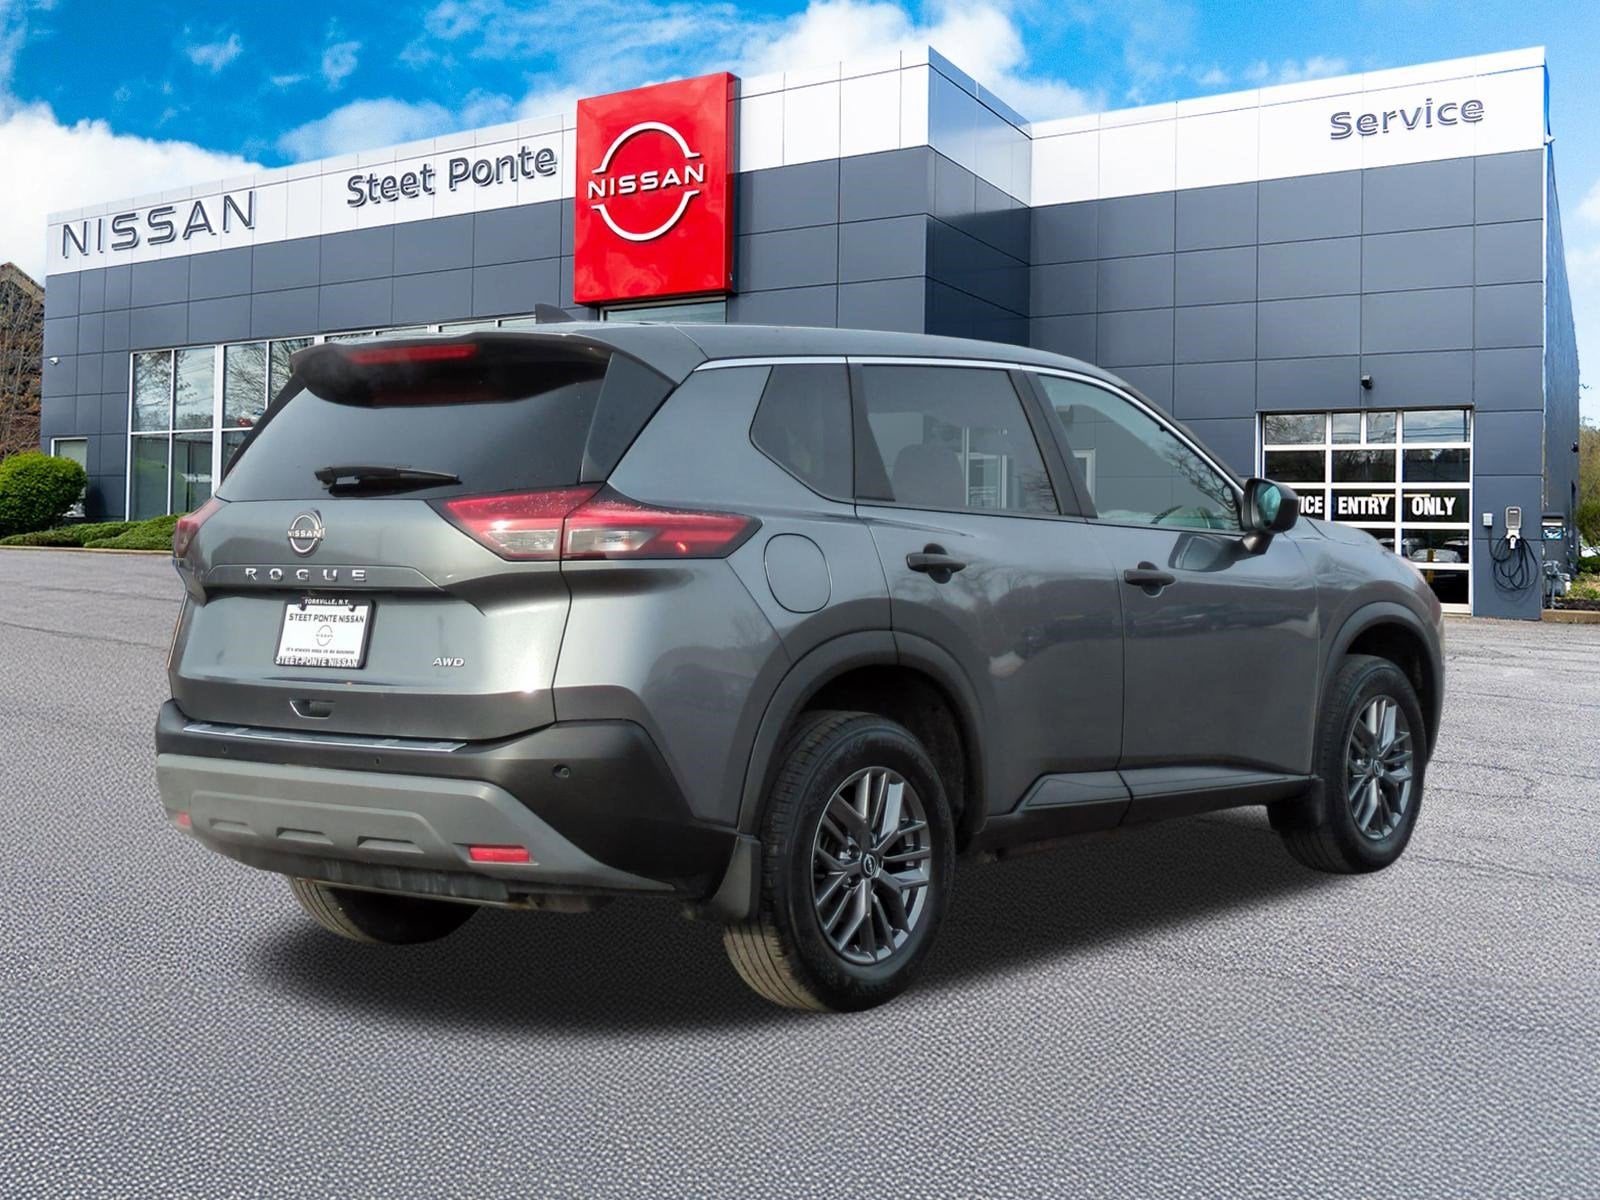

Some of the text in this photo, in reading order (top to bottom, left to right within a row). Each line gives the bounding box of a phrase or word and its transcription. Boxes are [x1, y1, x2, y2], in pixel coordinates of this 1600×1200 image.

[1330, 98, 1485, 140] Service
[346, 145, 558, 207] Steet Ponte
[587, 163, 706, 200] NISSAN
[61, 190, 257, 258] NISSAN
[1298, 496, 1457, 516] ICE ENTRY ONLY
[288, 528, 321, 538] NISSAN
[245, 567, 367, 582] ROGUE
[288, 613, 365, 623] STEET PONTE NISSAN
[328, 658, 358, 668] NISSAN
[432, 657, 465, 667] AWD
